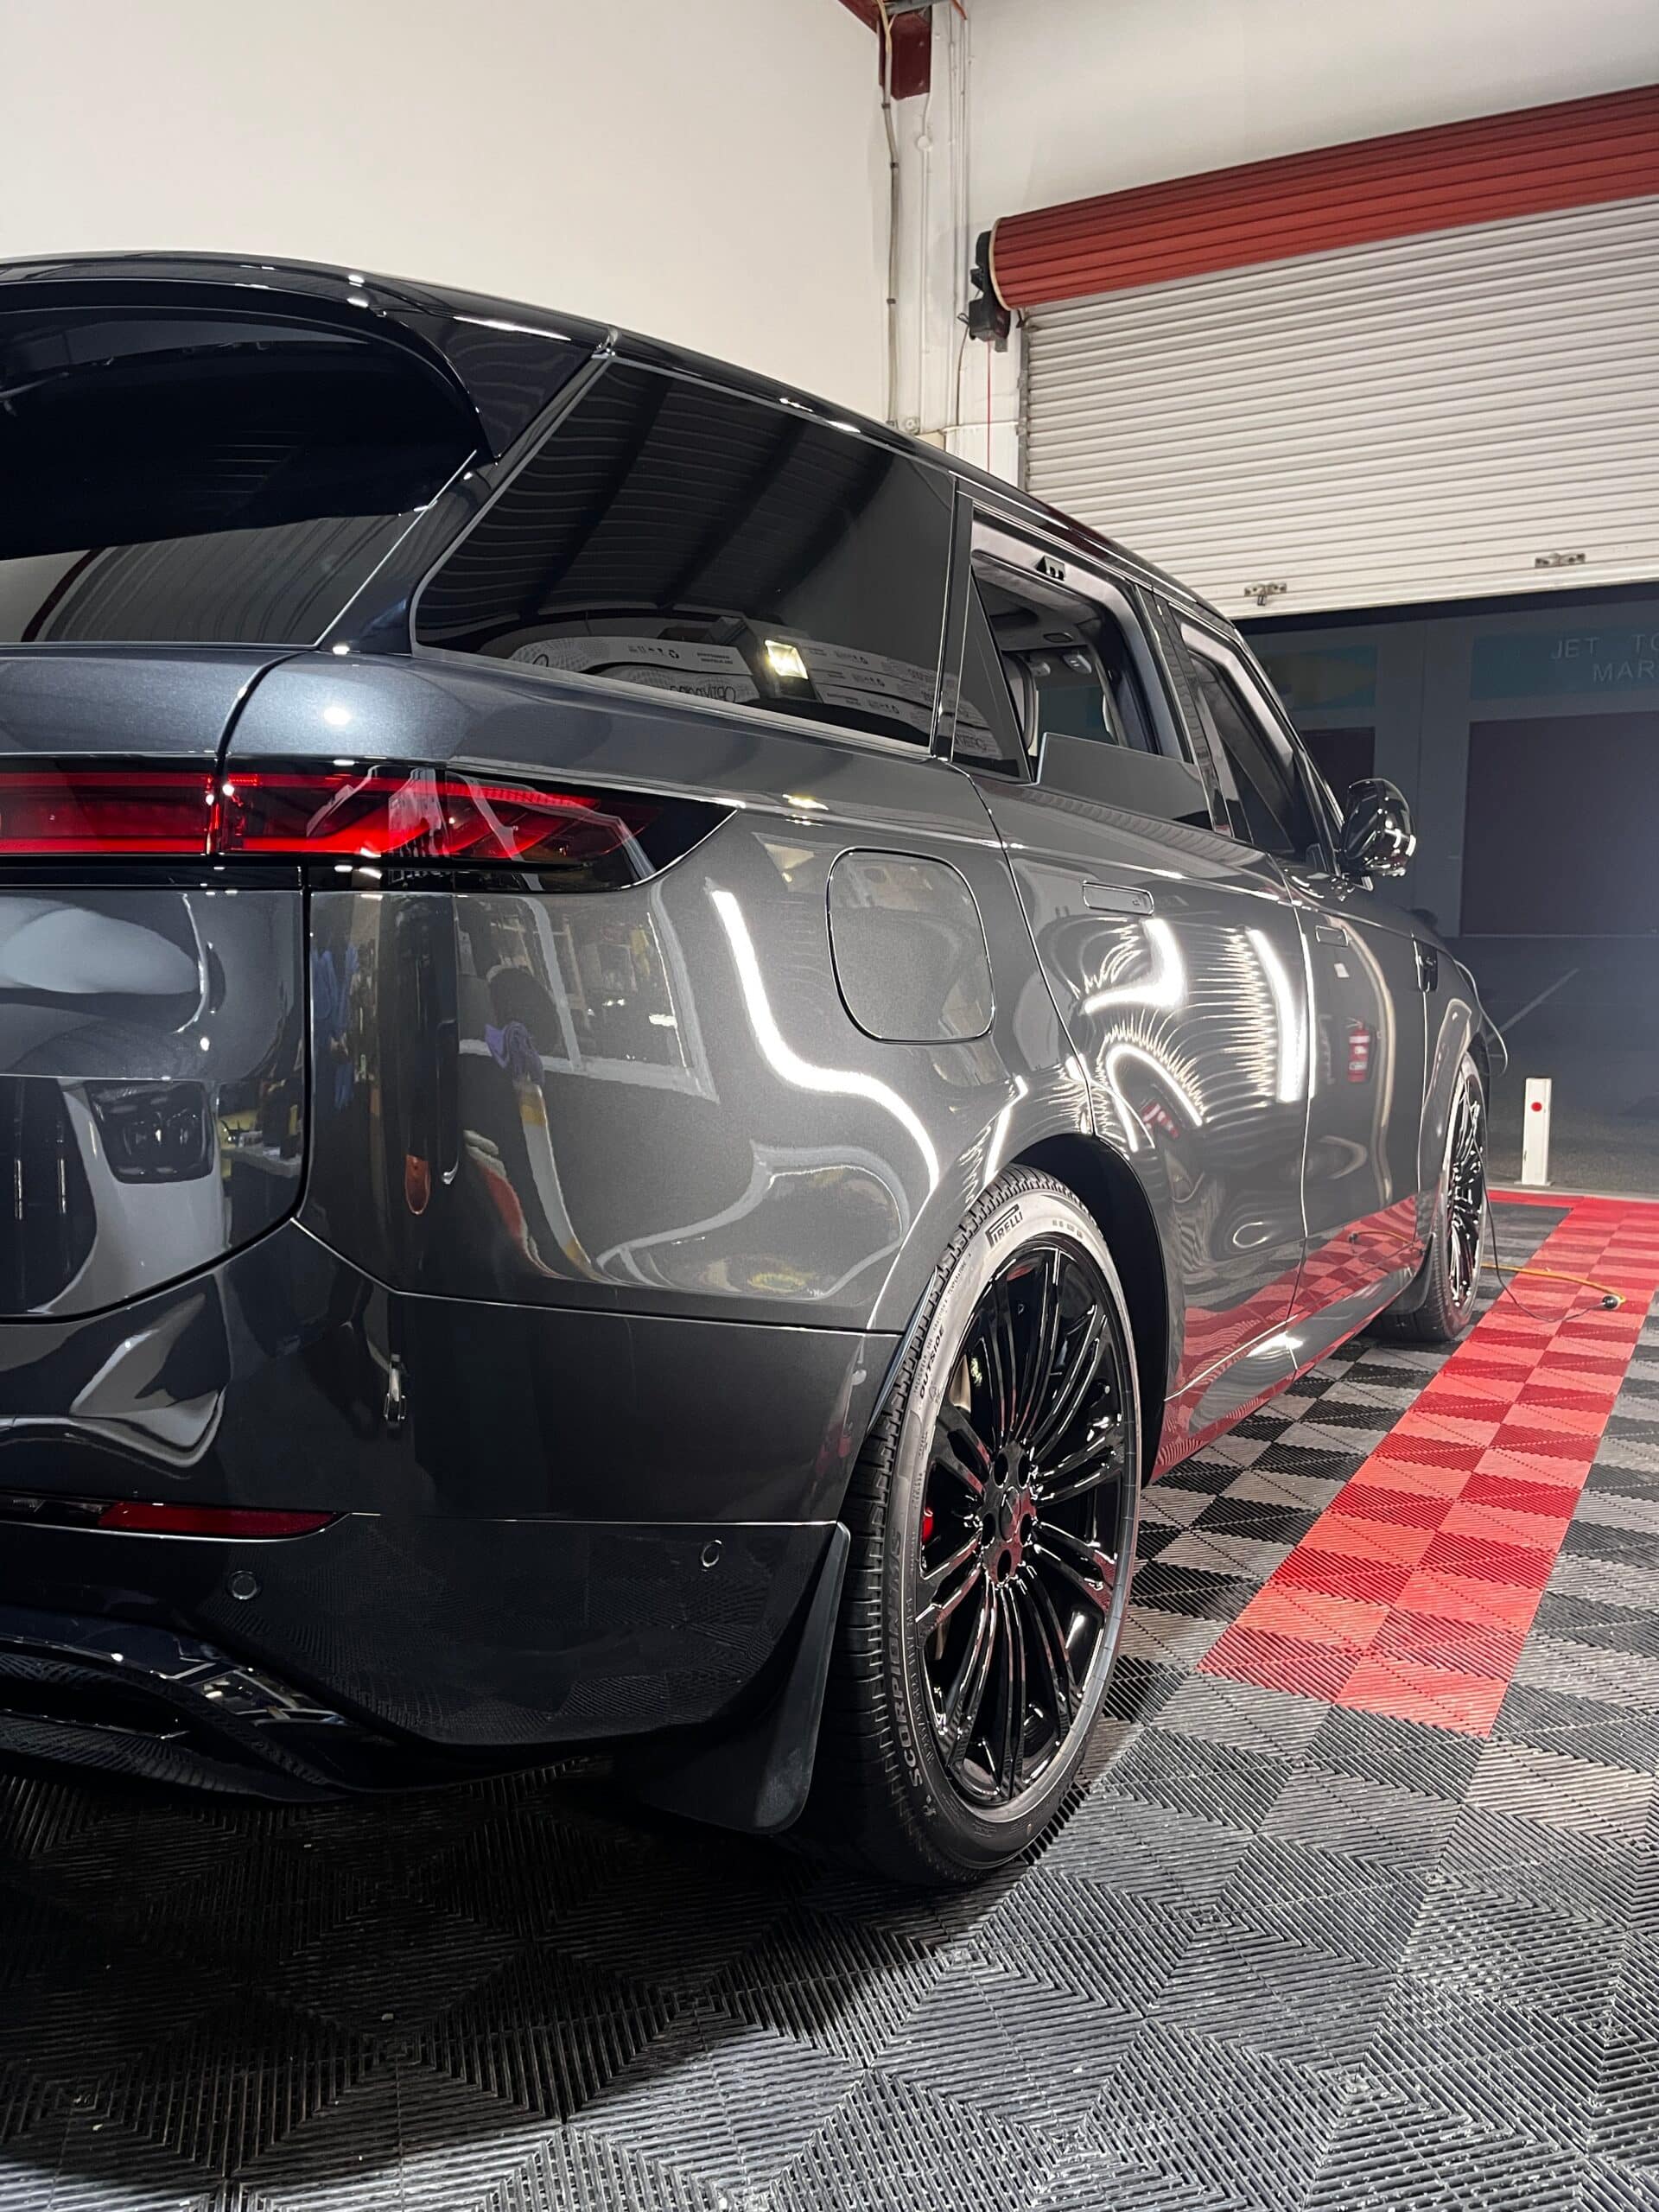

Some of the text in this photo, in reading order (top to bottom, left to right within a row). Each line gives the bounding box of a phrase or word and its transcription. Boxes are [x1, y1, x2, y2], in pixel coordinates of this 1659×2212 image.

[1551, 637, 1600, 658] JET
[984, 1204, 1023, 1249] PIRELLI
[919, 1324, 944, 1399] OUTSIDE
[888, 1607, 924, 1787] SCORPION
